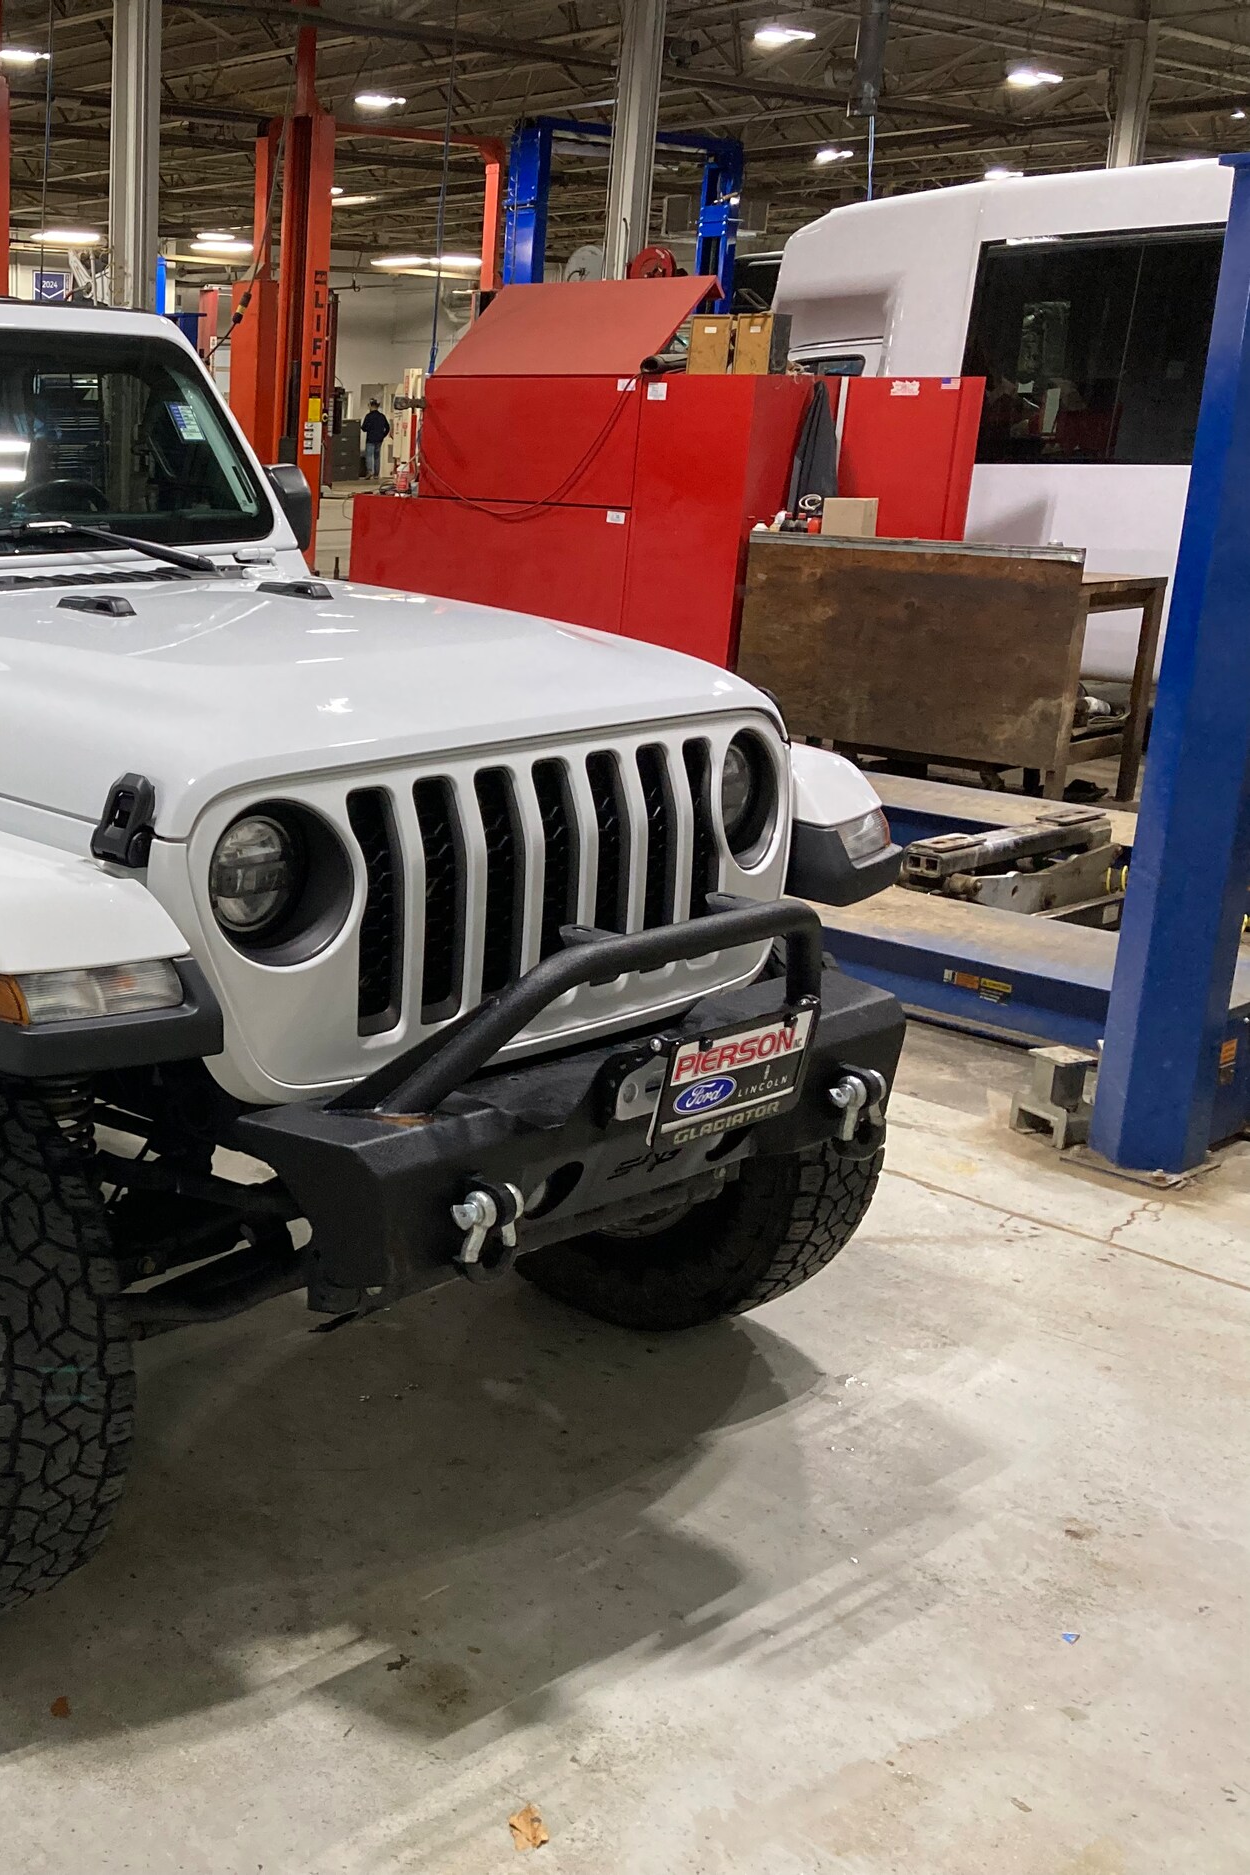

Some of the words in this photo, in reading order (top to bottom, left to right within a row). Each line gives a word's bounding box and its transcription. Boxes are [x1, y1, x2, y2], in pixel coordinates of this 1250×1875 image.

[41, 280, 58, 289] 2024
[310, 290, 324, 379] LIFT
[672, 1026, 796, 1082] PIERSON
[685, 1082, 721, 1108] Ford
[737, 1075, 788, 1098] LINCOLN
[673, 1101, 780, 1145] GLADIATOR
